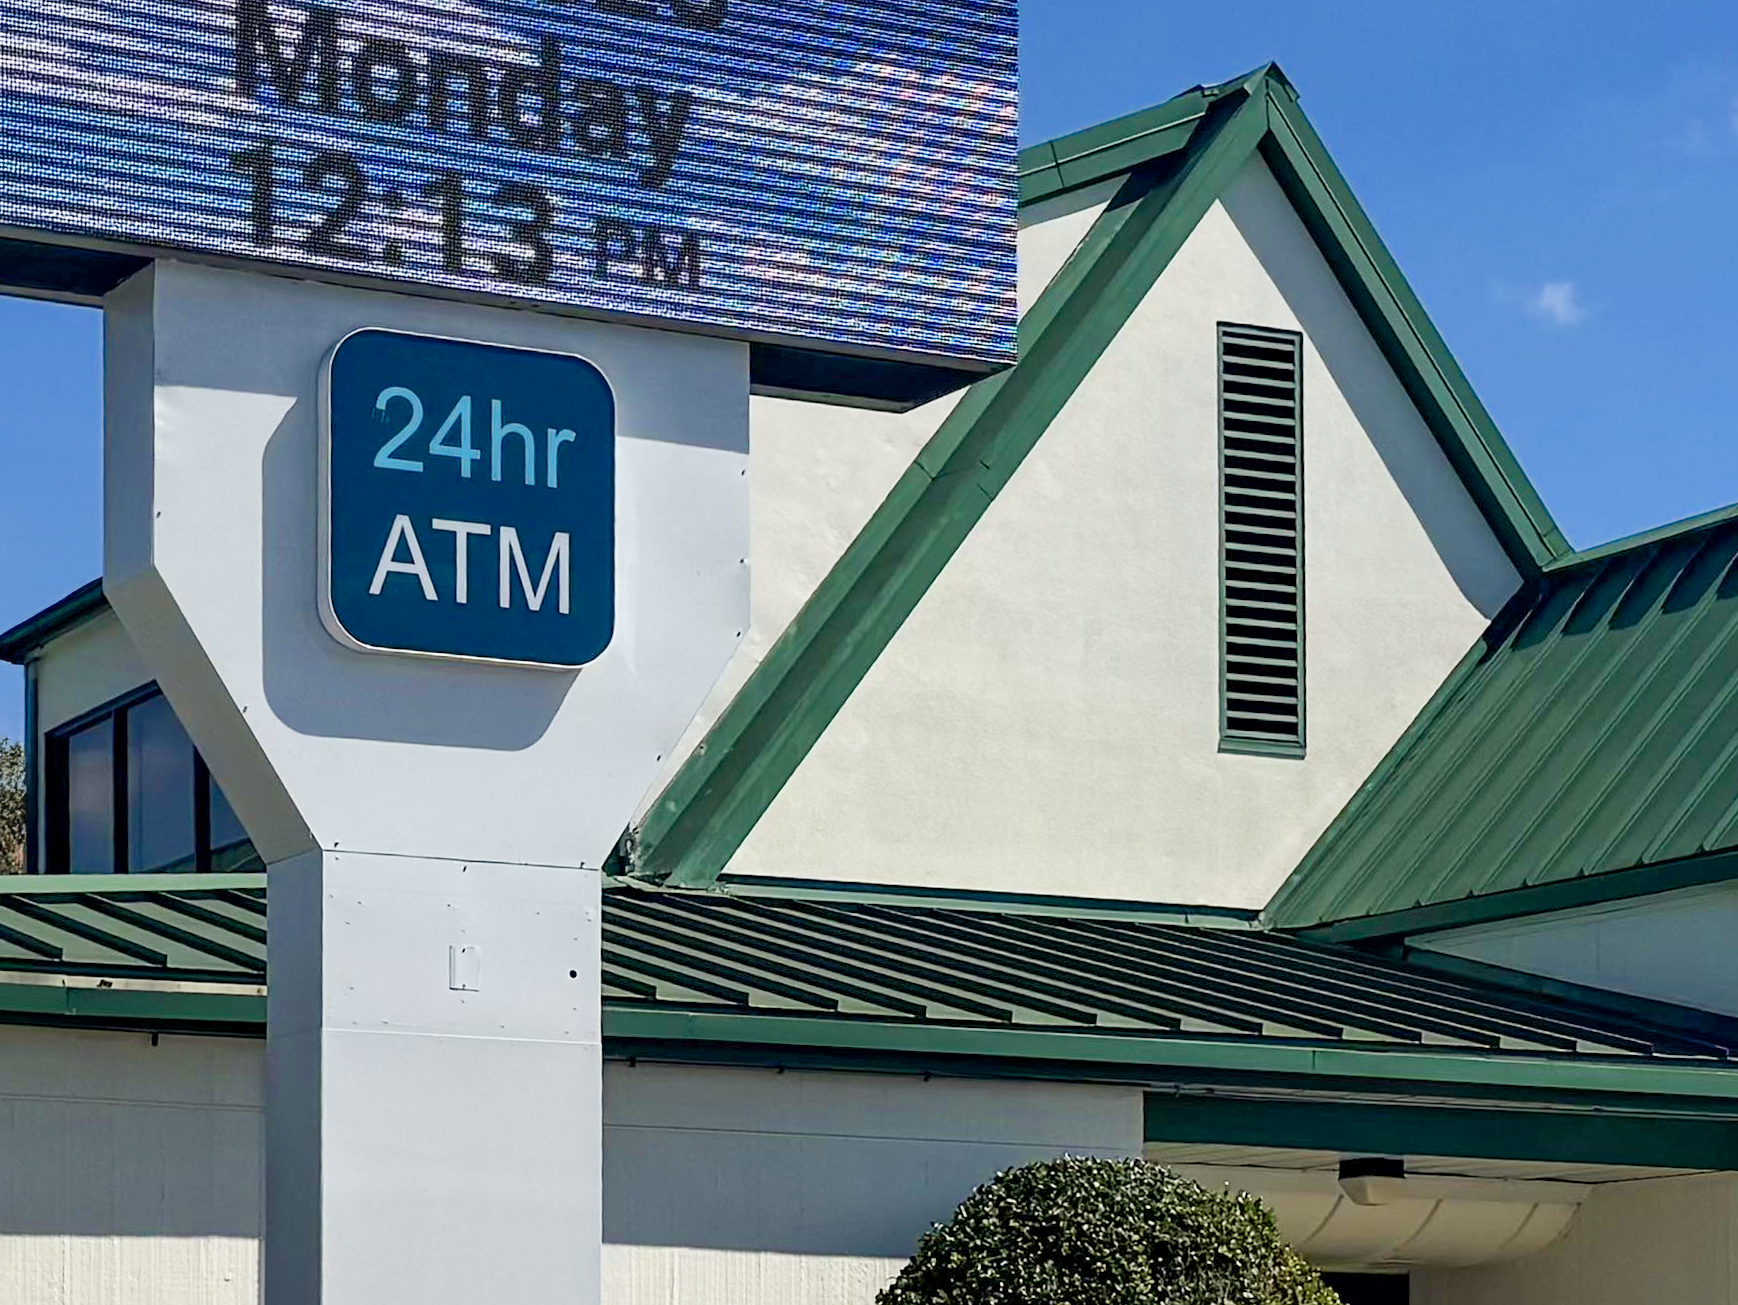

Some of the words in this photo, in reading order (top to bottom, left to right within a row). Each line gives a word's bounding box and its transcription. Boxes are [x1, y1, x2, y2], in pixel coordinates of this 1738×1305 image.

[232, 140, 553, 287] 12:13
[595, 216, 701, 292] PM
[373, 387, 577, 488] 24hr
[369, 515, 571, 614] ATM
